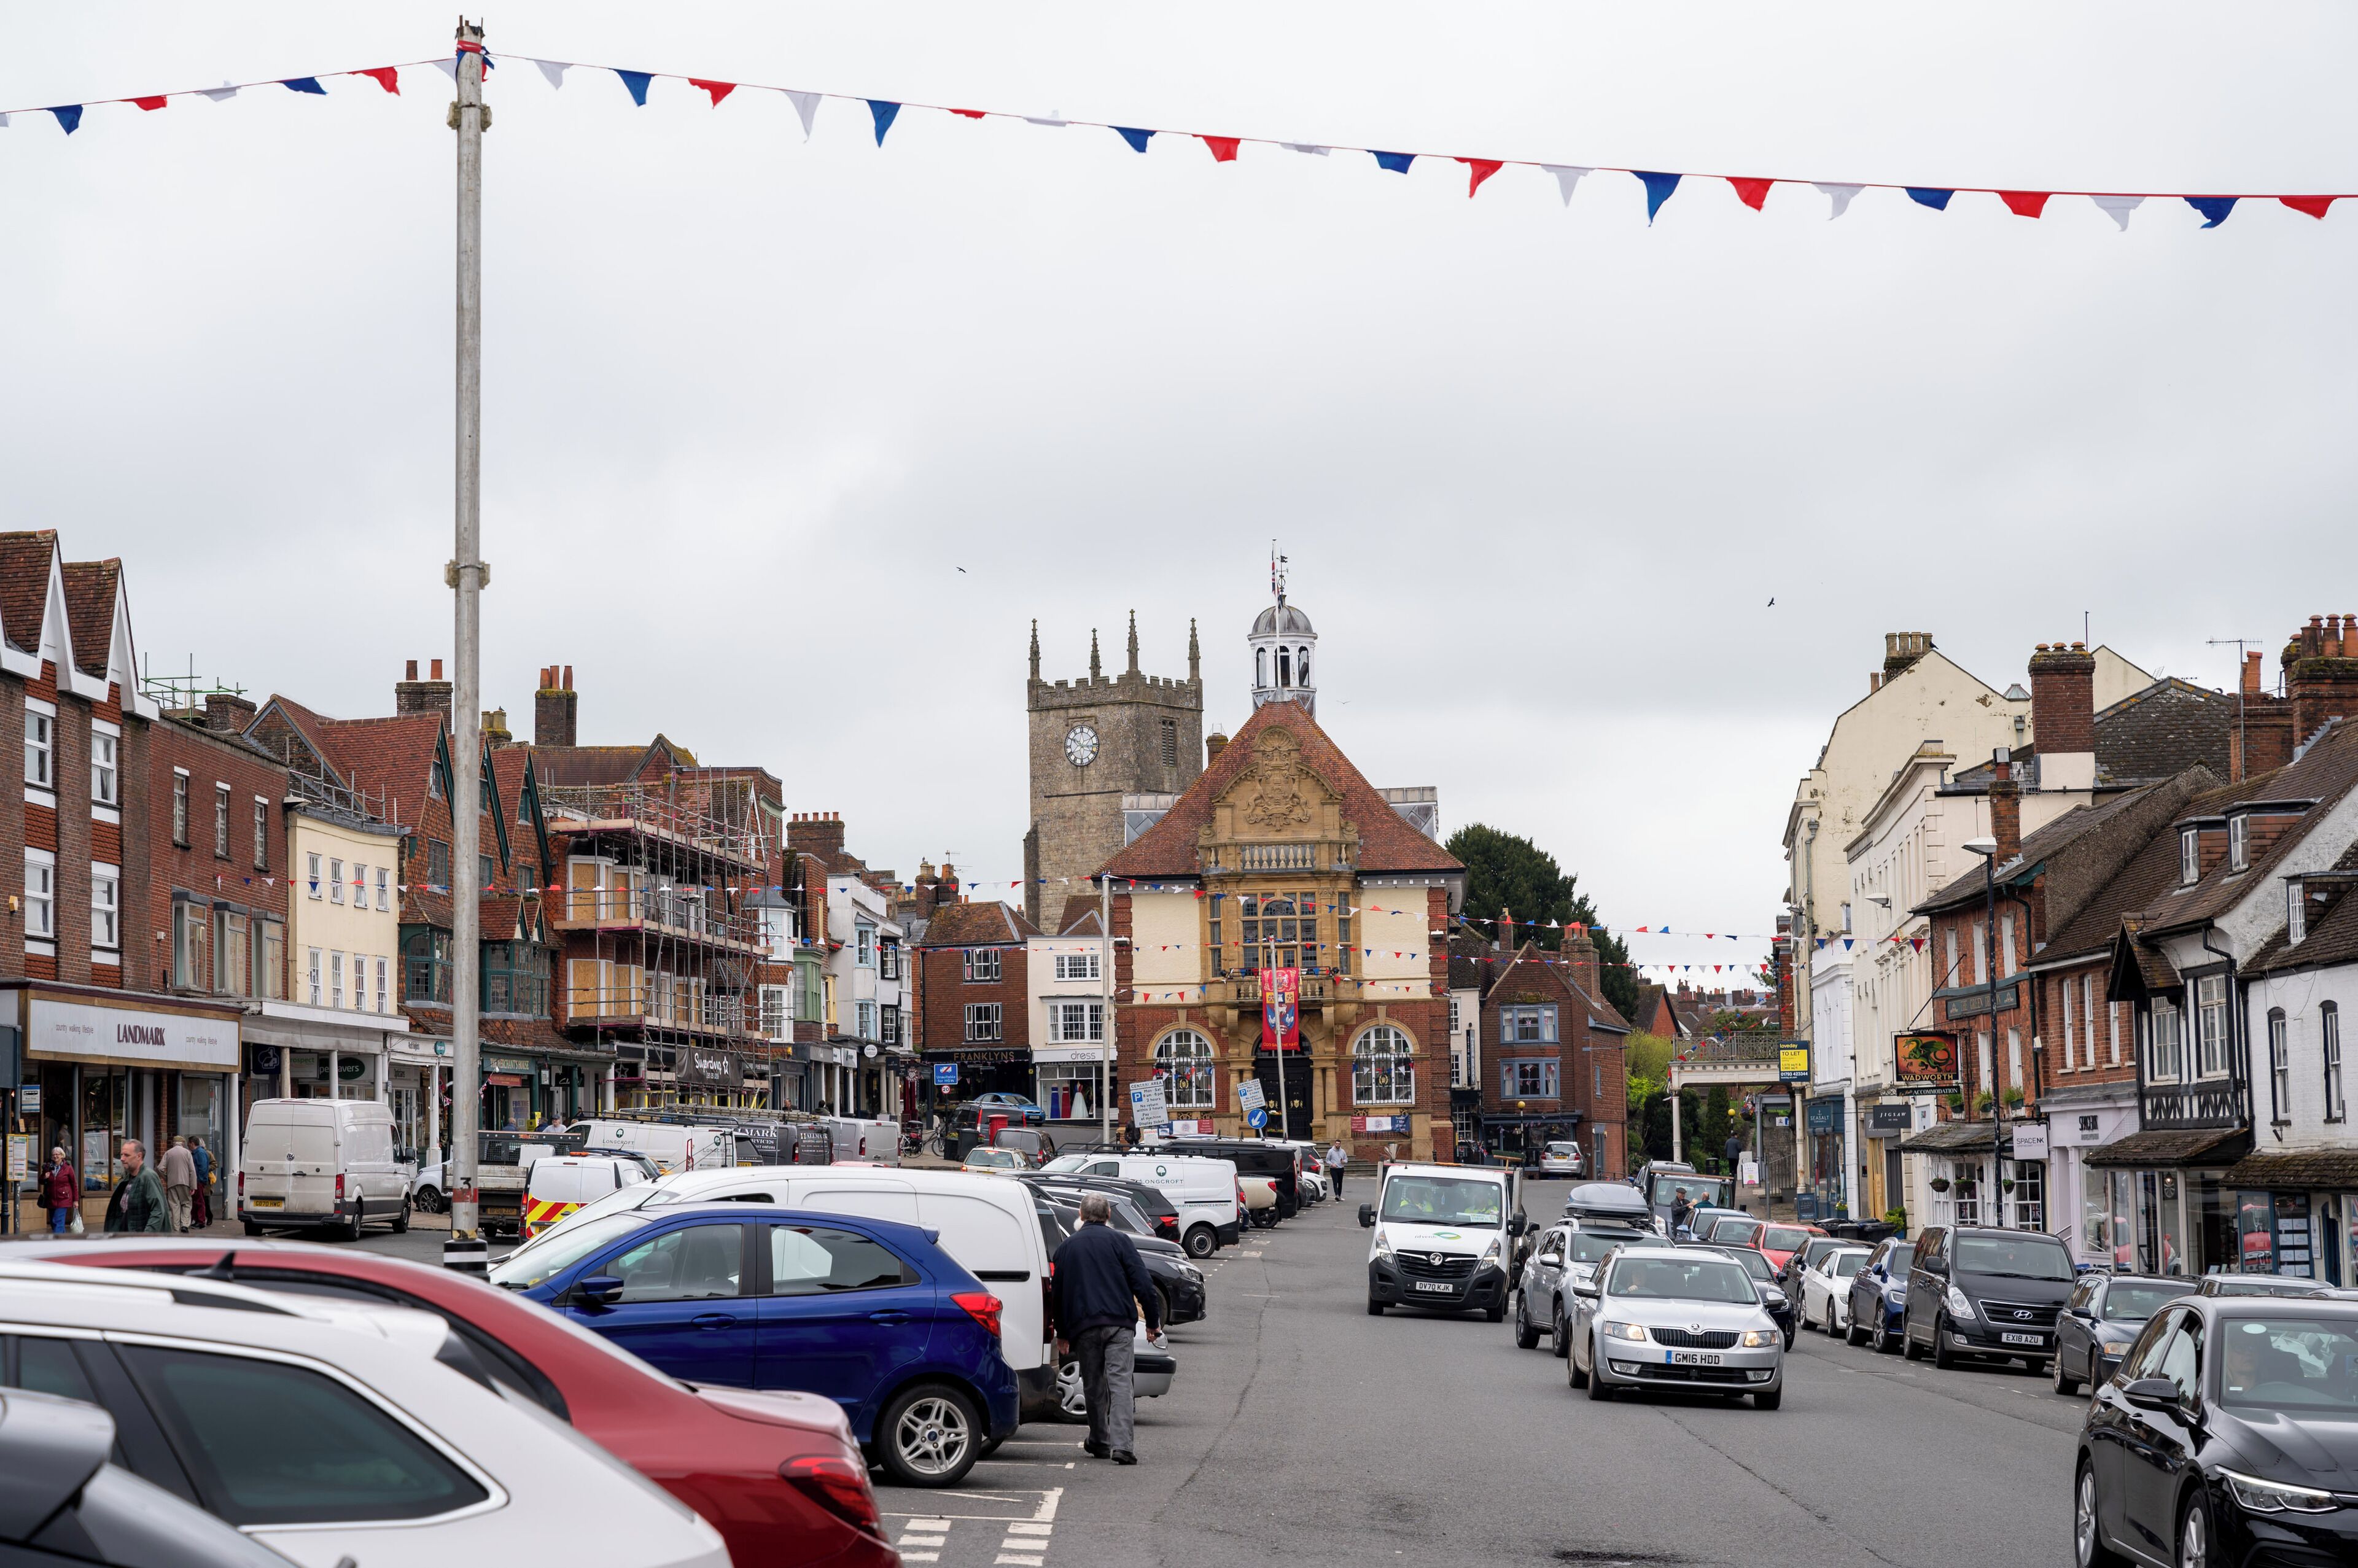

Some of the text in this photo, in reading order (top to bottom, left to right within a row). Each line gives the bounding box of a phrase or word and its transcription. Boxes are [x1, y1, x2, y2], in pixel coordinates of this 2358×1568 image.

[1969, 997, 1983, 1010] GREEN
[56, 1024, 93, 1035] country walking lifestyle
[117, 1023, 165, 1046] LANDMARK
[208, 1037, 217, 1046] lifestyle
[954, 1051, 1014, 1061] FRANKLYNS
[1071, 1051, 1095, 1060] dress
[497, 1058, 518, 1069] MERCHANT'S
[518, 1060, 529, 1069] HOUSE
[695, 1052, 722, 1072] Superdrug
[319, 1063, 359, 1074] peavers
[1134, 1093, 1141, 1101] P
[461, 1177, 472, 1189] 3
[1675, 1353, 1719, 1364] GM16 HDD
